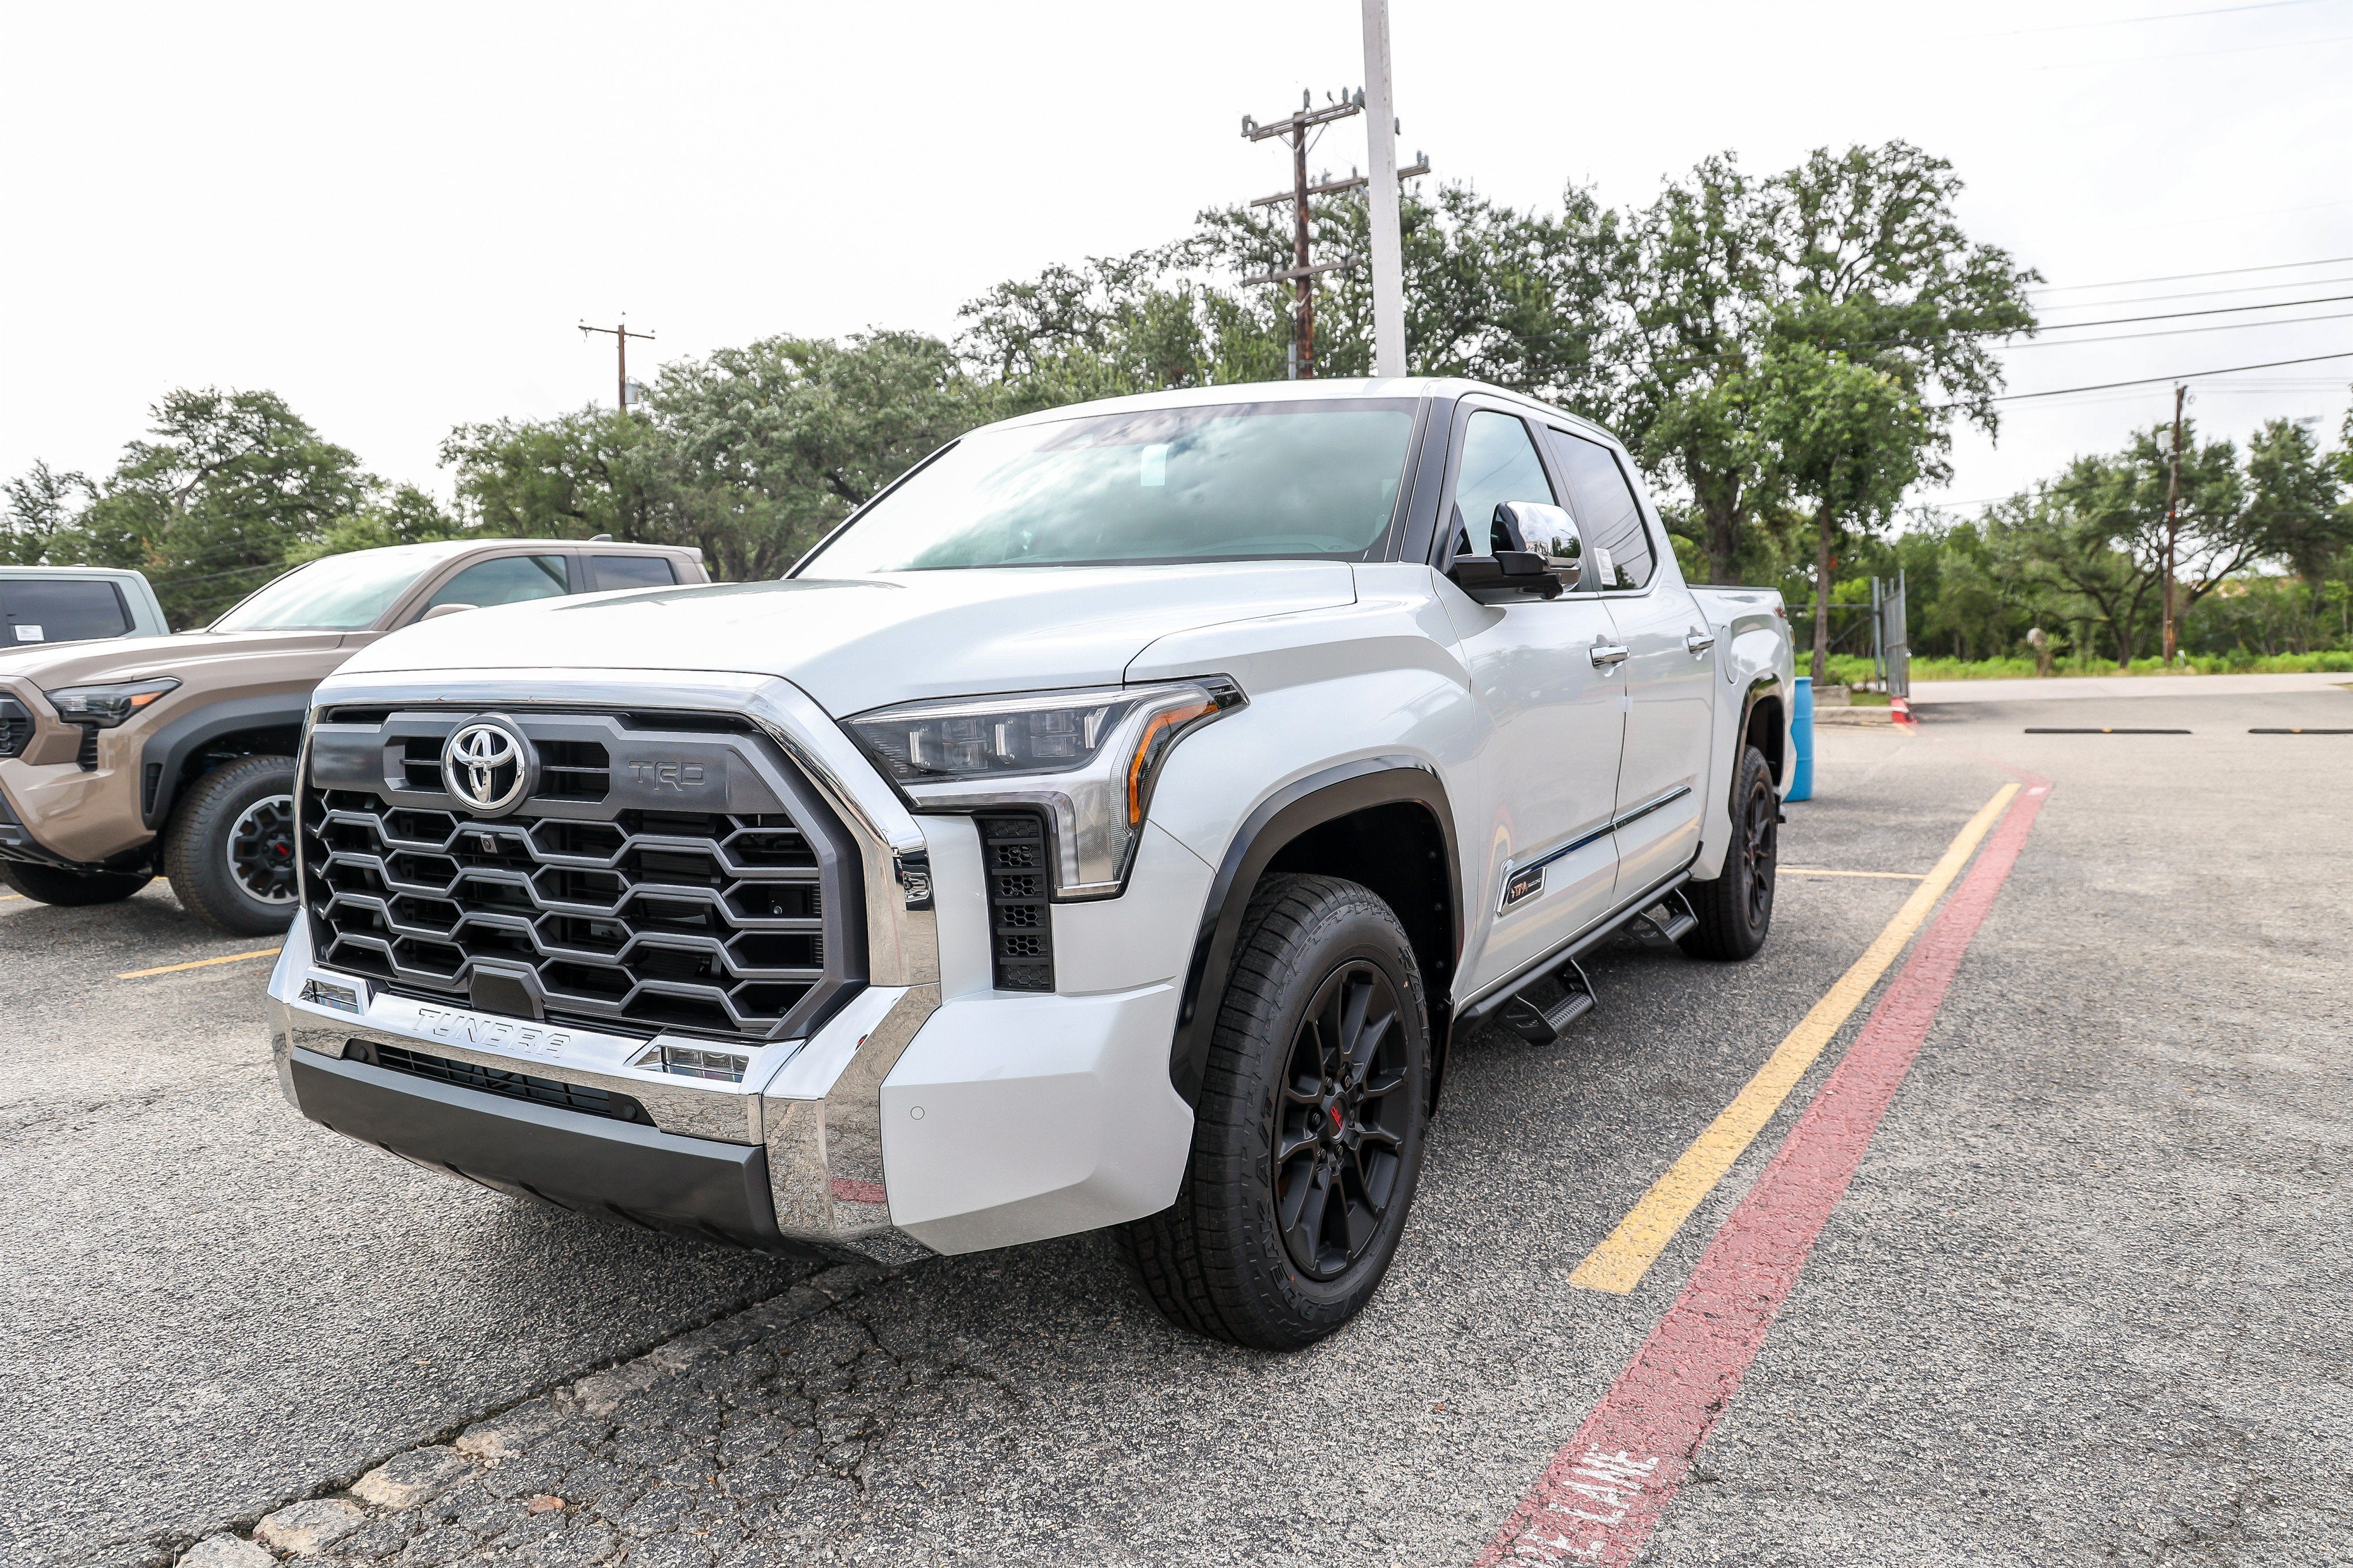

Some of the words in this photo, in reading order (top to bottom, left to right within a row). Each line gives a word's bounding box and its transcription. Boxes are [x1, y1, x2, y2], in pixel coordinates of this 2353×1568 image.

[628, 760, 705, 791] TRD
[413, 1008, 571, 1059] TUNDRA
[1548, 1442, 1660, 1524] LANE
